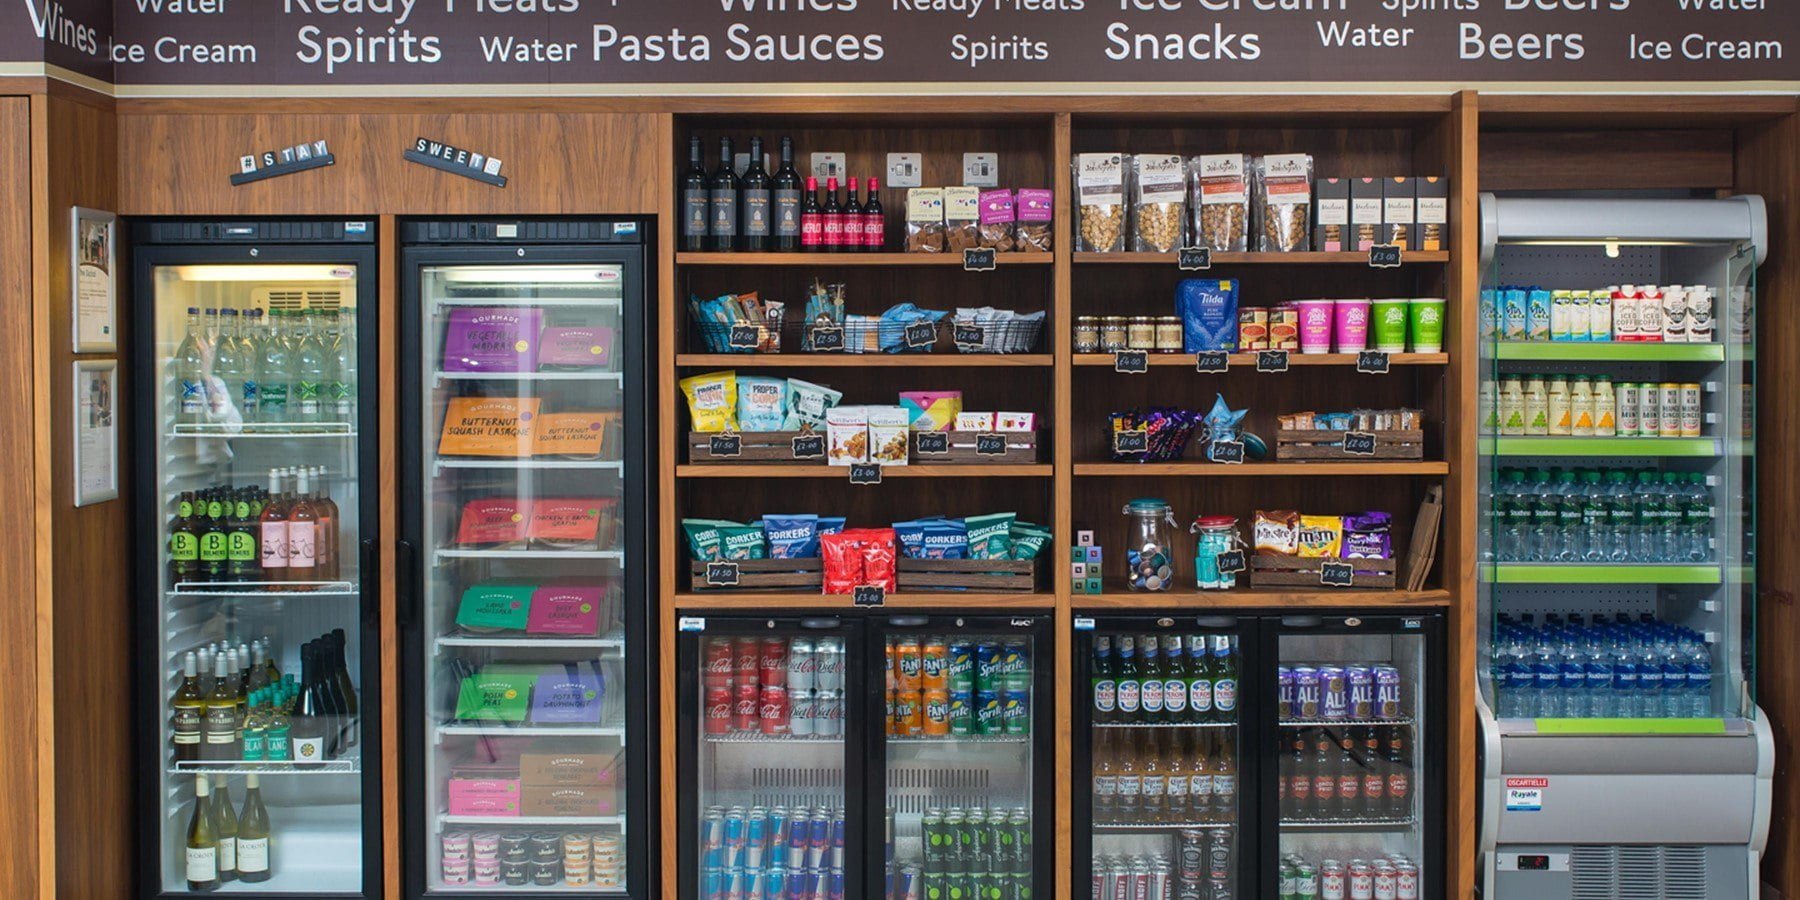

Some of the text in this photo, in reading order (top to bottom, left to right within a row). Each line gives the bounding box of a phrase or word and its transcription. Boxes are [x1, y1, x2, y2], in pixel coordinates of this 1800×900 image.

[593, 23, 885, 62] Pasta Sauces
[1105, 22, 1262, 60] Snacks
[1317, 20, 1415, 47] Water
[1459, 22, 1585, 60] Beers
[108, 36, 257, 63] Ice Cream
[296, 25, 442, 74] Spirits
[480, 36, 578, 62] Water
[950, 33, 1050, 67] Spirits
[1630, 33, 1783, 60] Ice Cream
[1199, 292, 1224, 304] Tilda
[752, 385, 779, 394] PROPER
[461, 417, 518, 426] BUTTERNUT
[448, 427, 531, 437] SQUASH LASAGNE
[768, 528, 811, 540] CORKERS
[967, 521, 1009, 538] CORKERS
[176, 535, 187, 549] B
[209, 535, 220, 549] B
[925, 535, 967, 544] CORKERS
[1349, 545, 1382, 554] buttons
[949, 661, 973, 676] Sprite
[1296, 685, 1319, 703] ALE
[1325, 691, 1346, 709] ALE
[1351, 685, 1373, 703] ALE
[1377, 685, 1400, 703] ALE
